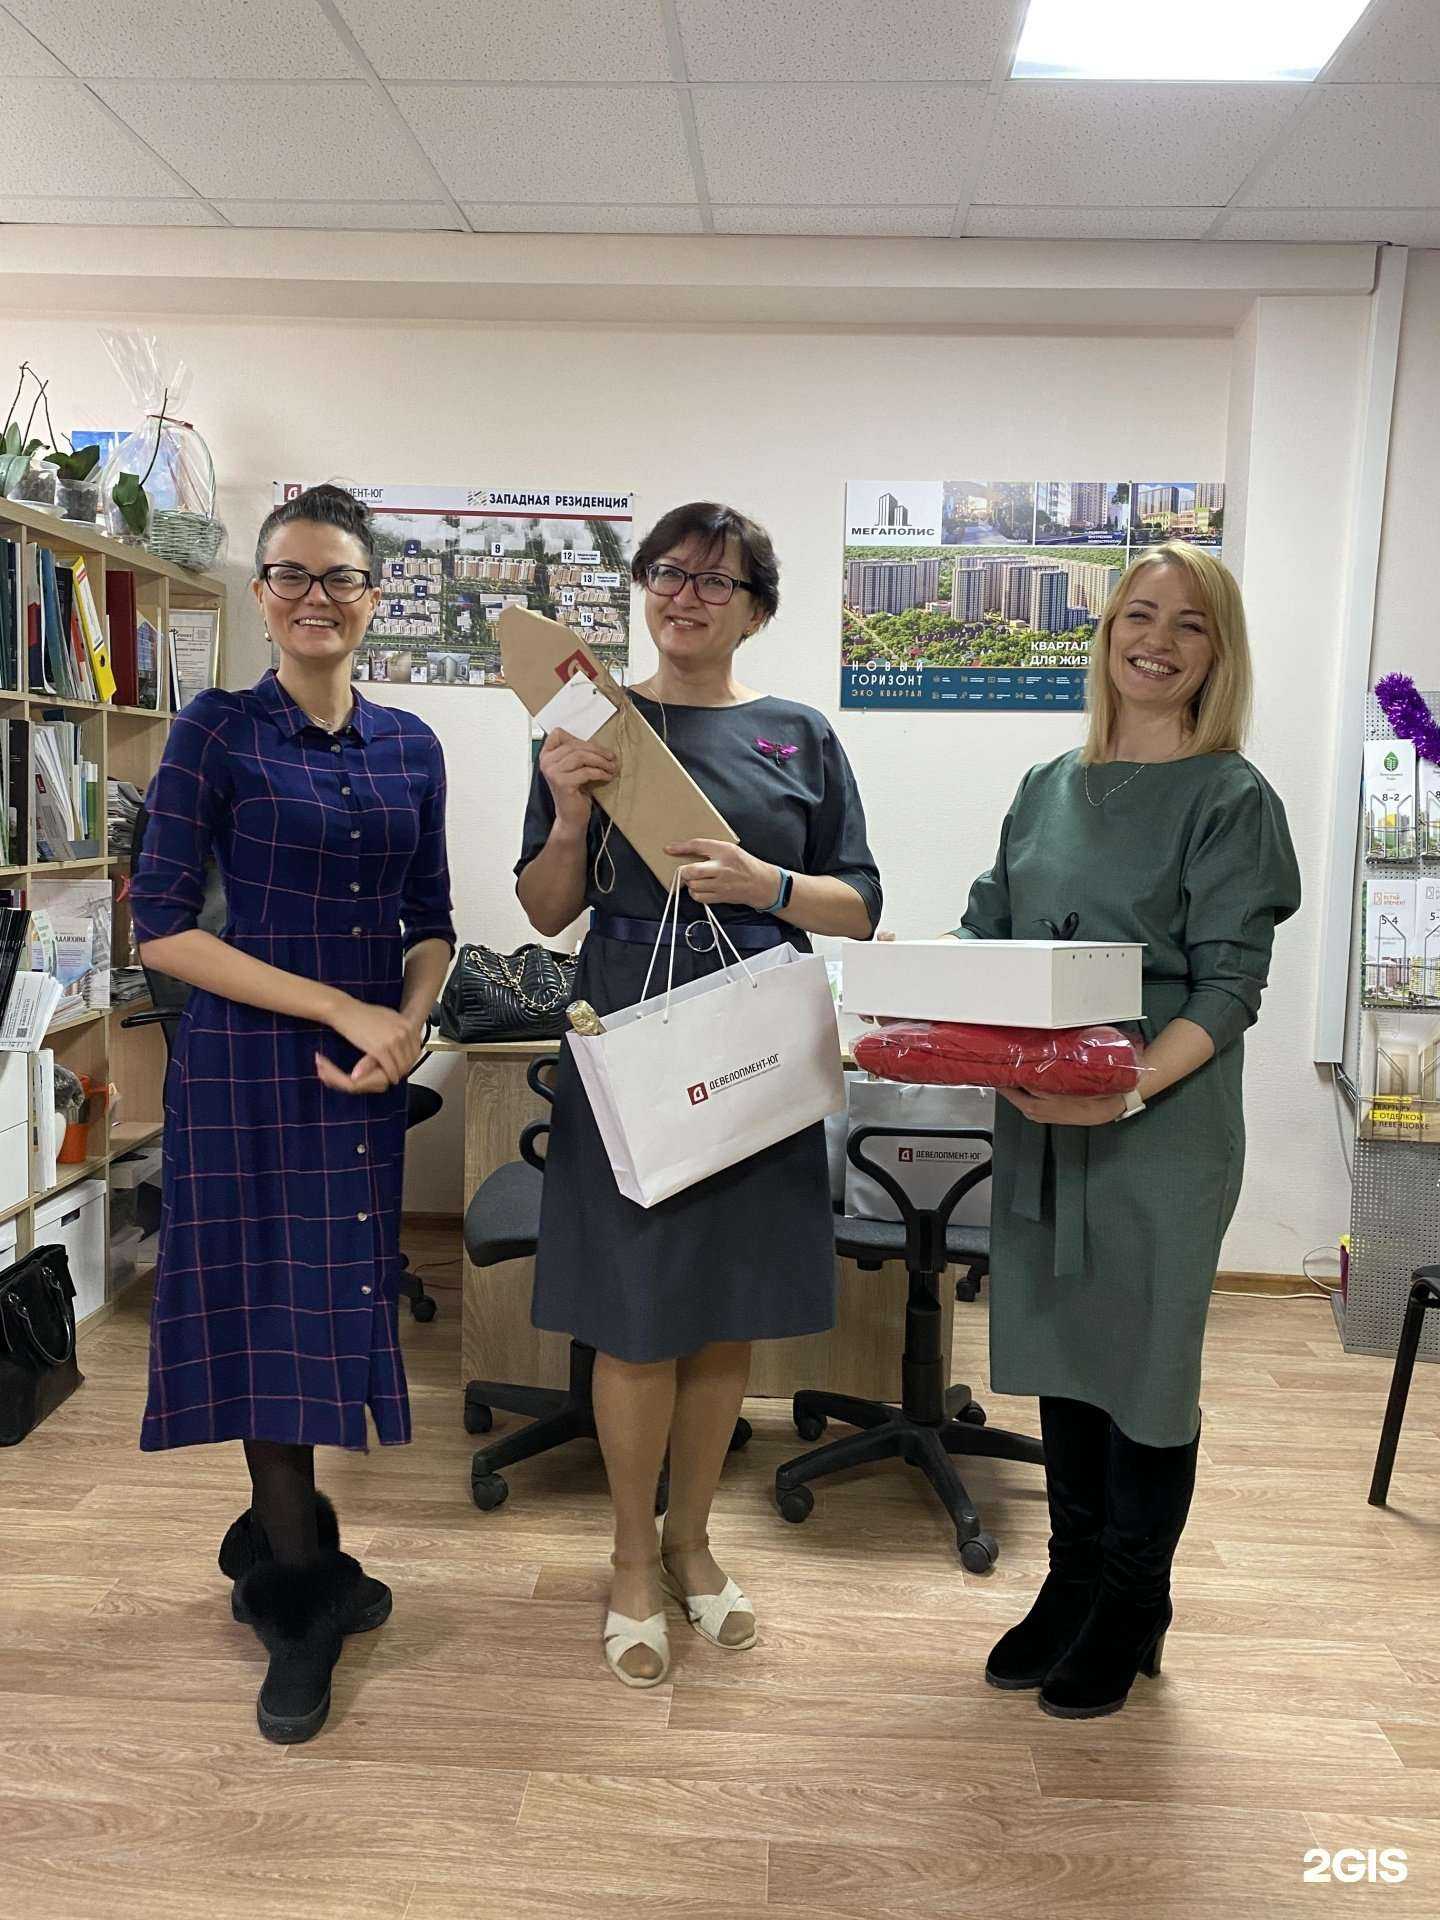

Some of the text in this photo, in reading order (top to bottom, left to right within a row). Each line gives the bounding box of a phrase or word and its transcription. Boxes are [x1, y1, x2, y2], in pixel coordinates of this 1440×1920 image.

[489, 493, 628, 509] ЗАПАДНАЯ РЕЗИДЕНЦИЯ
[851, 527, 936, 536] МЕГАПОЛИС
[495, 543, 501, 554] 9
[563, 552, 573, 560] 12
[583, 574, 593, 583] 13
[564, 594, 573, 603] 14
[583, 614, 592, 623] 15
[1030, 641, 1089, 651] КВАРТАЛ
[1029, 655, 1057, 667] ДЛЯ
[851, 674, 923, 686] ГОРИЗОНТ
[851, 689, 873, 697] ЭКО
[1382, 793, 1400, 802] 8-2
[1381, 916, 1399, 925] 54
[709, 1053, 779, 1091] ДЕВЕЛОПМЕНТ-ЮГ
